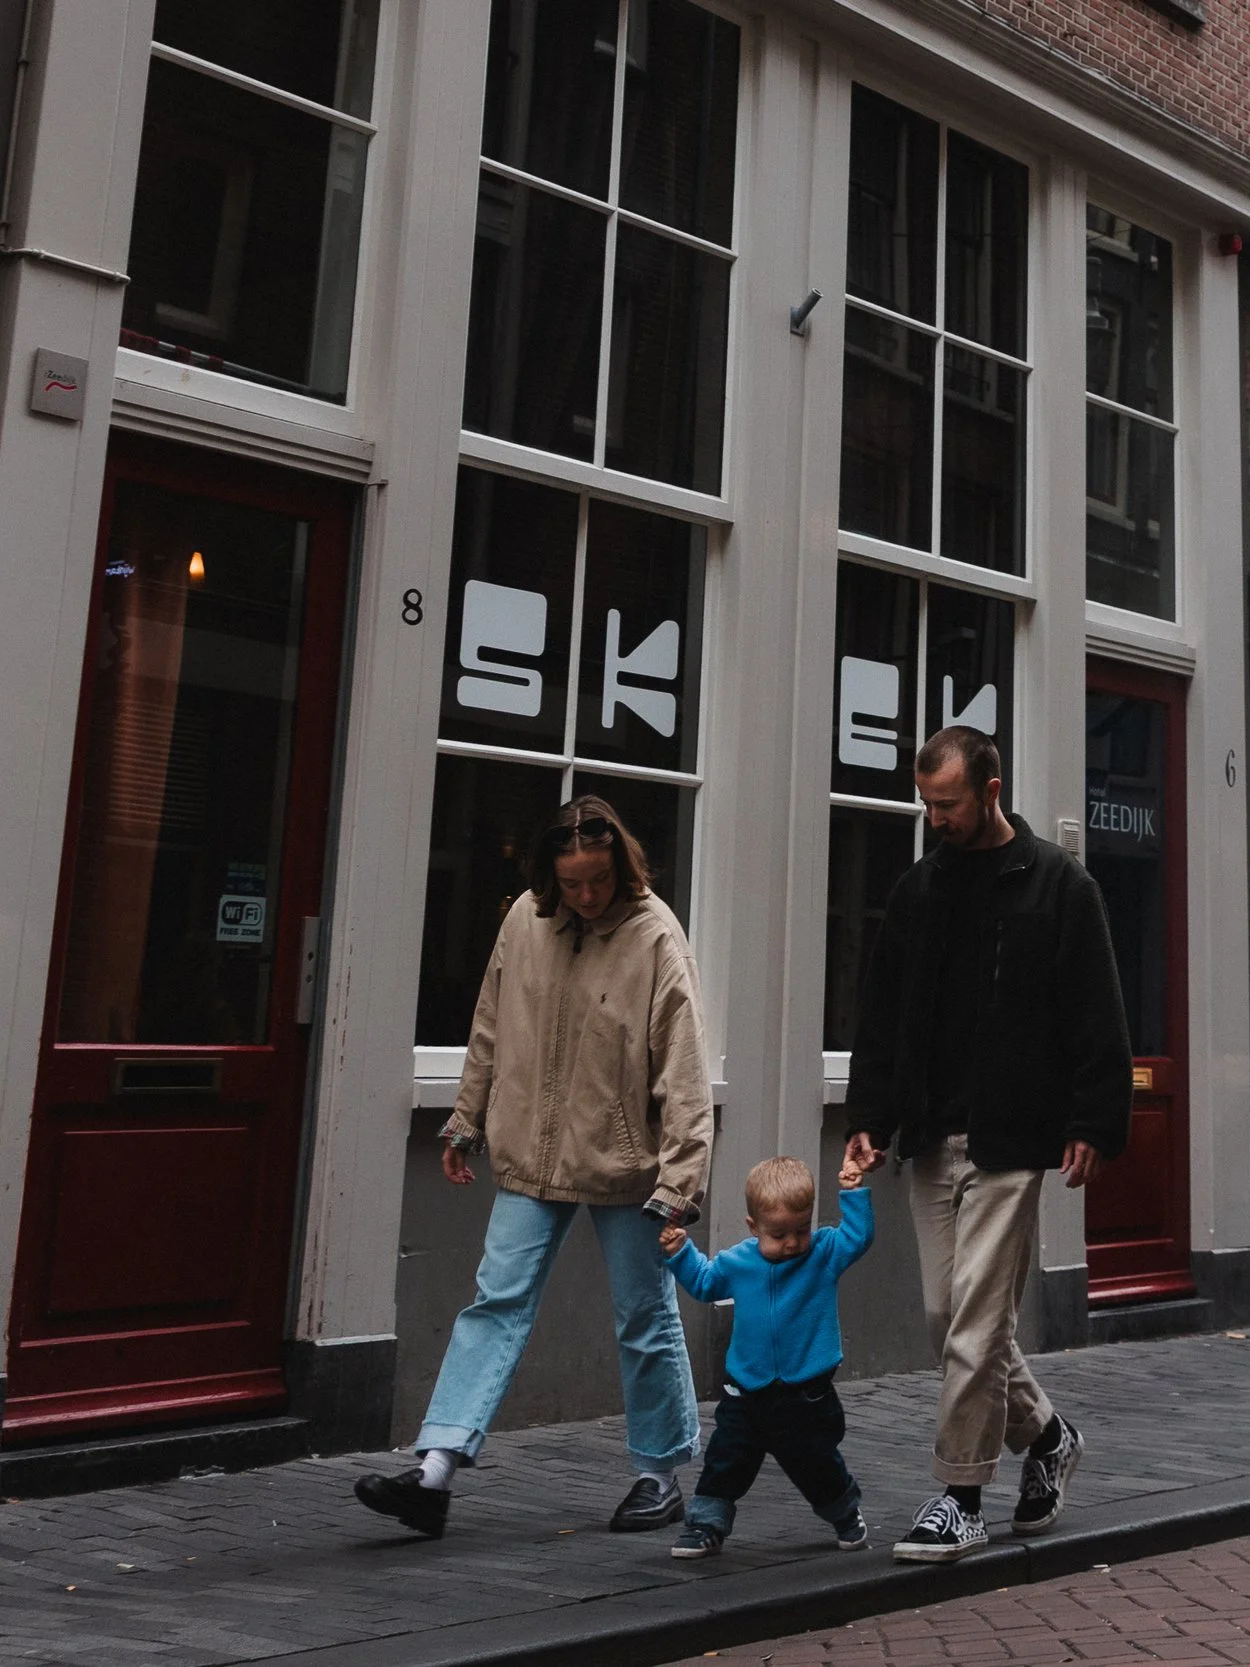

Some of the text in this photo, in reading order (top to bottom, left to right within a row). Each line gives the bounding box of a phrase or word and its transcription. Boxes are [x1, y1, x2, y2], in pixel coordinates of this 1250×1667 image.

[402, 588, 423, 625] 8
[1226, 749, 1236, 788] 6
[1089, 801, 1156, 843] ZEEDIJK
[220, 927, 262, 937] FREE ZONE
